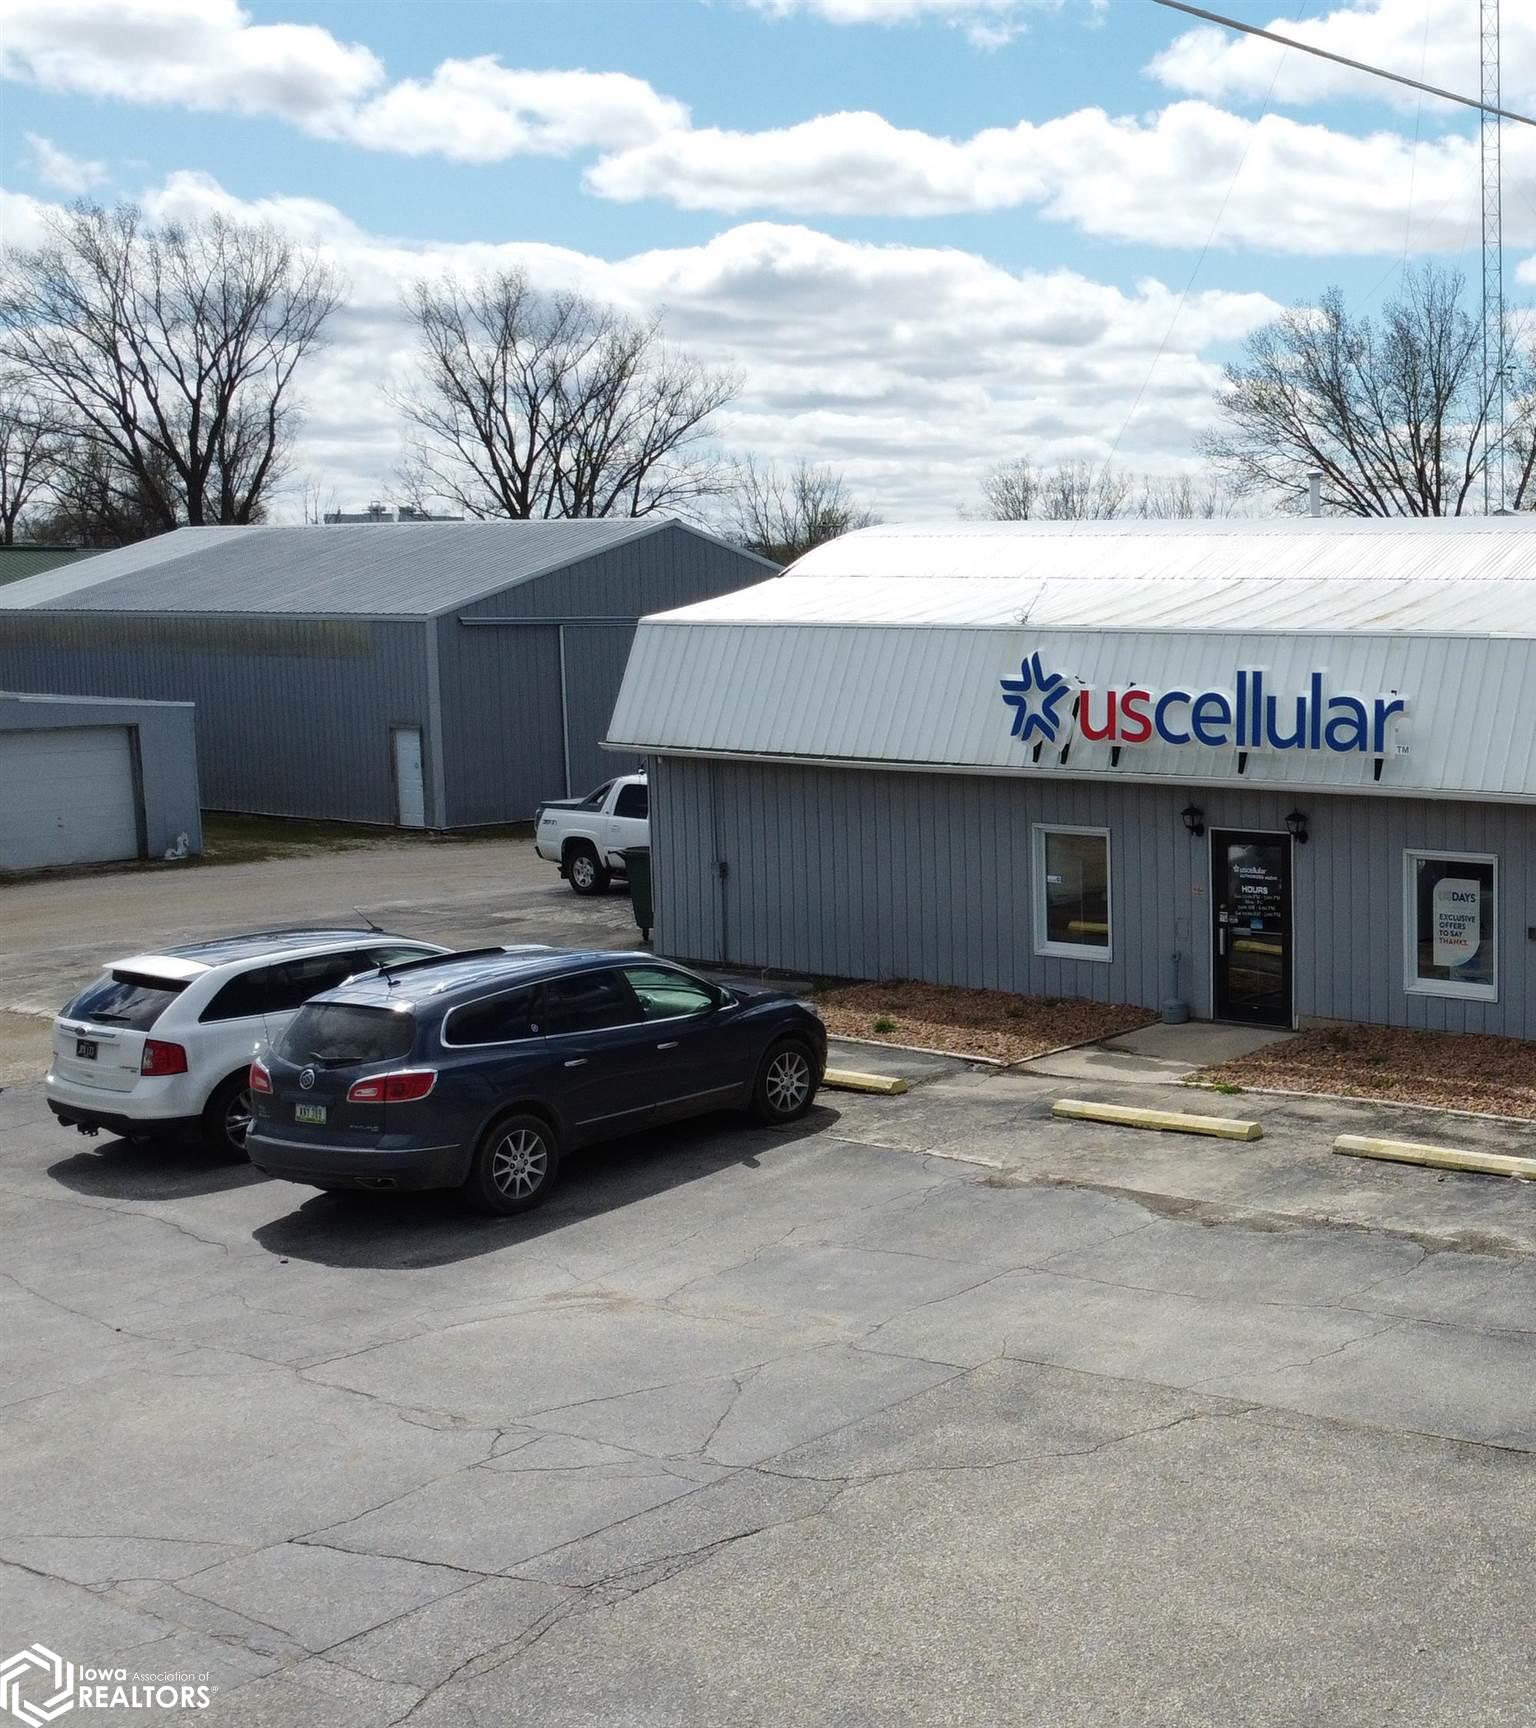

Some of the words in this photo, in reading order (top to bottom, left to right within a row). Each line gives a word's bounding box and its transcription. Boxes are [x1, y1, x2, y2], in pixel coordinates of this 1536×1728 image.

[1079, 670, 1405, 753] uscellular
[1241, 885, 1268, 894] HOURS
[1439, 913, 1475, 923] EXCLUSIVE
[1439, 922, 1466, 930] OFFERS
[1450, 930, 1463, 938] SAY
